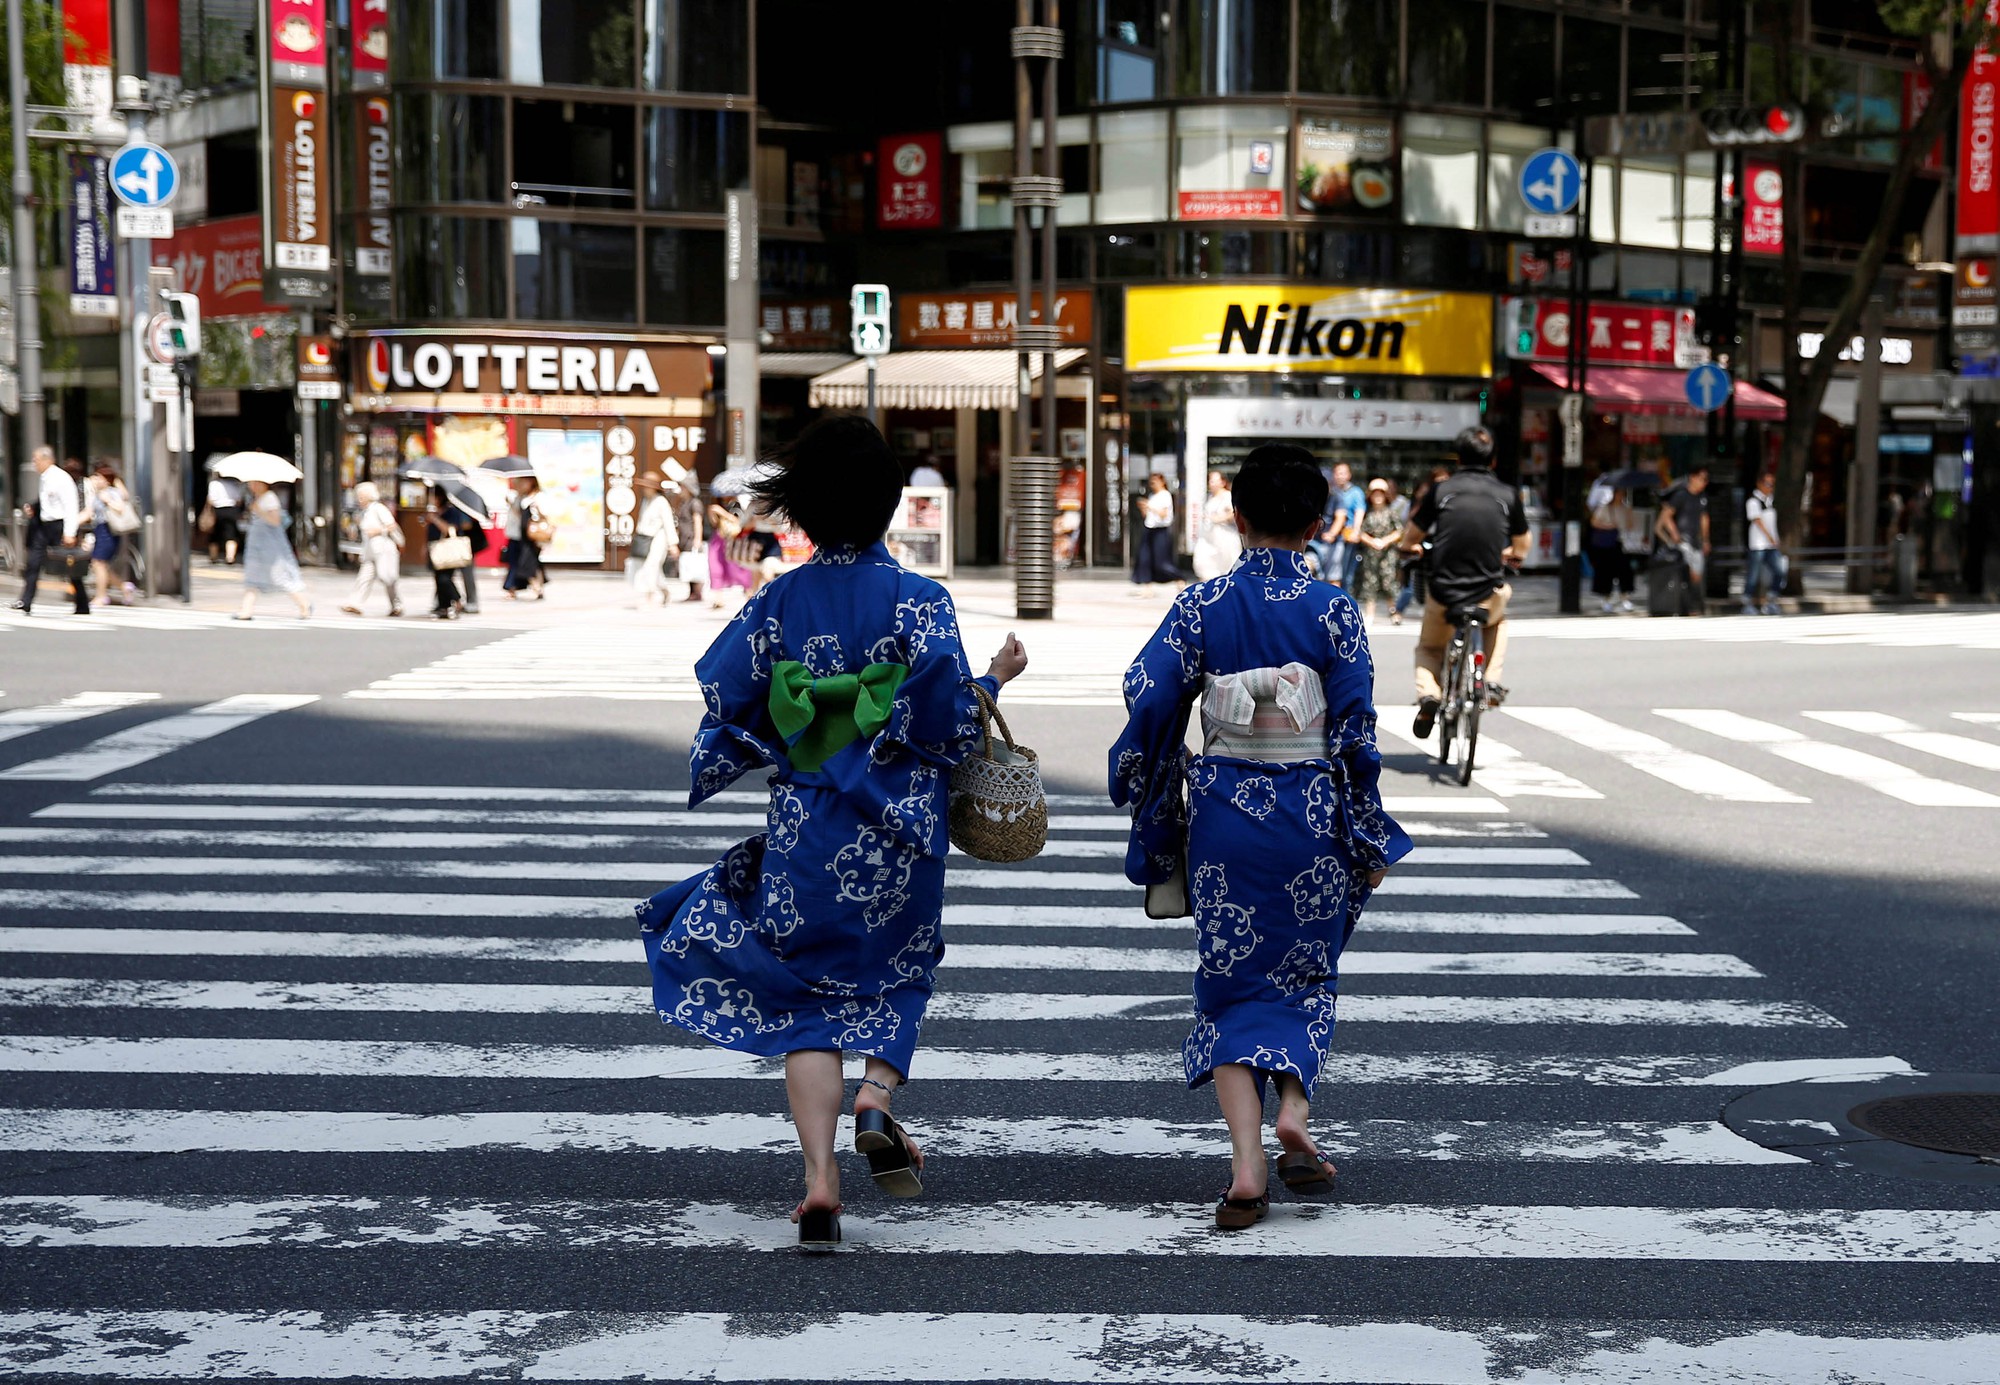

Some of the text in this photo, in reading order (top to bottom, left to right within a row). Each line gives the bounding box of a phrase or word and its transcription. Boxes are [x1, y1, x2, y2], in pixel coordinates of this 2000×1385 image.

[1969, 82, 1995, 193] SHOES
[294, 120, 317, 242] LOTTERIA
[1218, 303, 1406, 359] Nikon
[1590, 317, 1672, 352] 不二家
[391, 342, 661, 393] LOTTERIA
[653, 425, 706, 452] B1F
[605, 455, 636, 478] 45
[606, 514, 635, 536] 10
